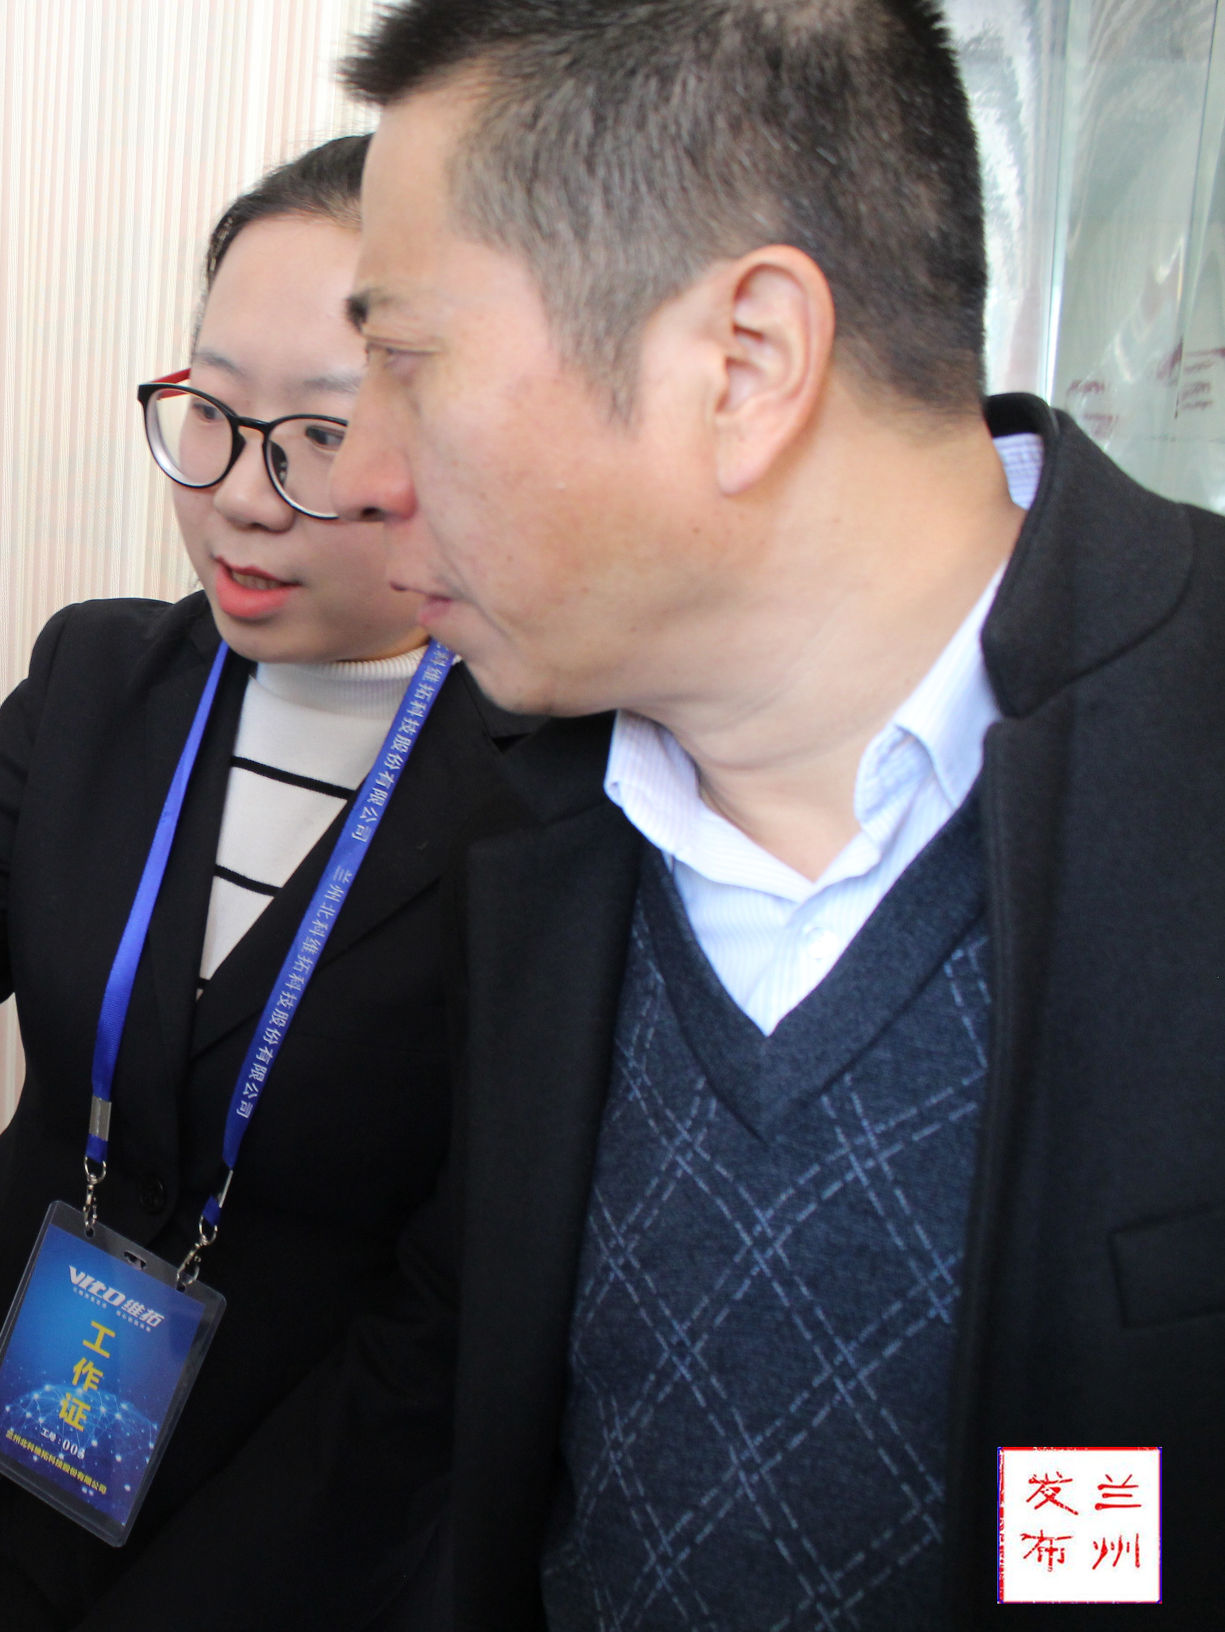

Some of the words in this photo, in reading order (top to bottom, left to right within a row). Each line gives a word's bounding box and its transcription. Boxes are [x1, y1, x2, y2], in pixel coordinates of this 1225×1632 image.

[351, 643, 451, 843] 科维拓科技股份有限公司
[236, 865, 353, 1120] 兰州北科维拓科技股份有限公司
[57, 1319, 117, 1432] 工作证
